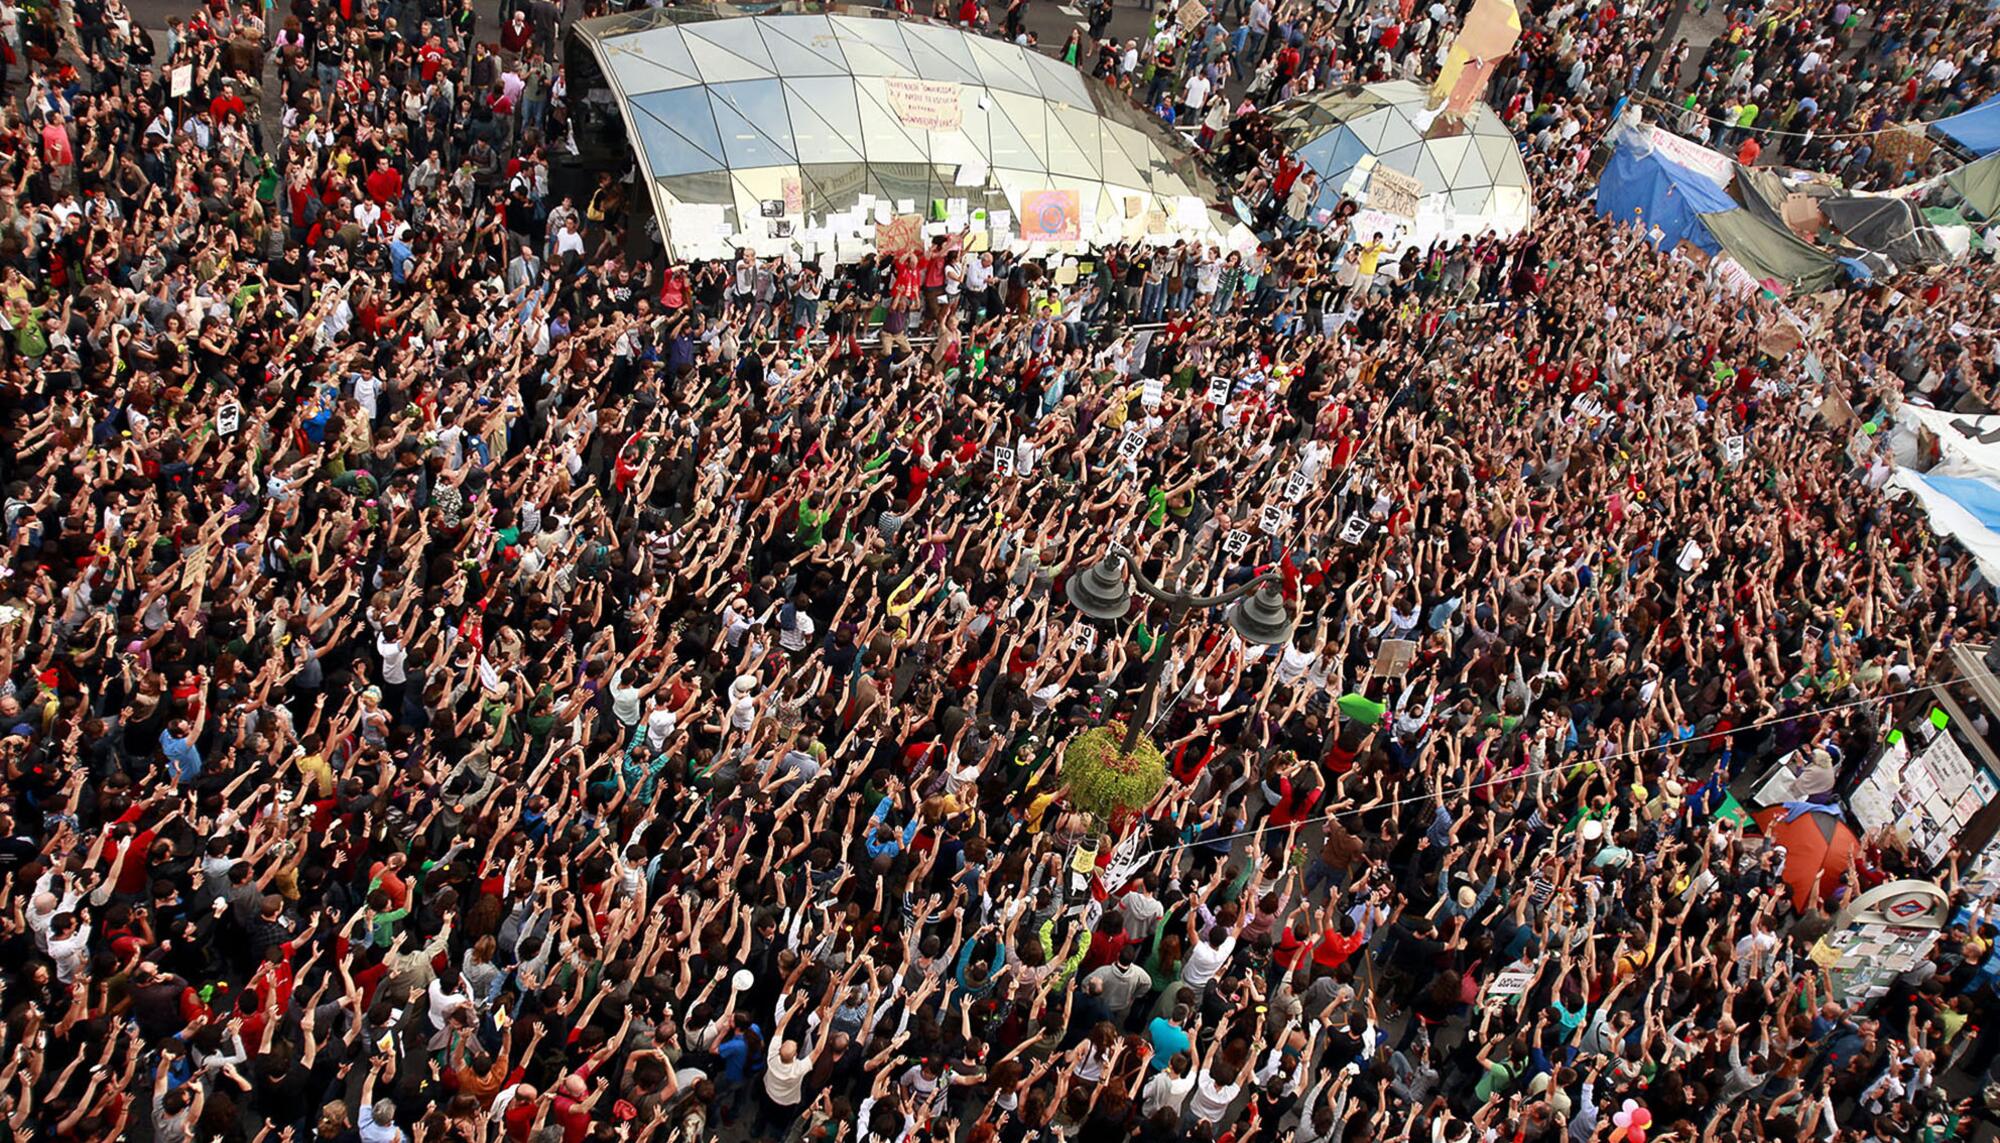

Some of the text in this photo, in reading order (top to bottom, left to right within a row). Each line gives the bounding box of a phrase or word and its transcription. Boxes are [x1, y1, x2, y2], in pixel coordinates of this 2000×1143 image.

[1128, 432, 1144, 447] NO
[997, 448, 1011, 459] NO
[1292, 472, 1305, 487] NO
[1231, 531, 1247, 543] NO
